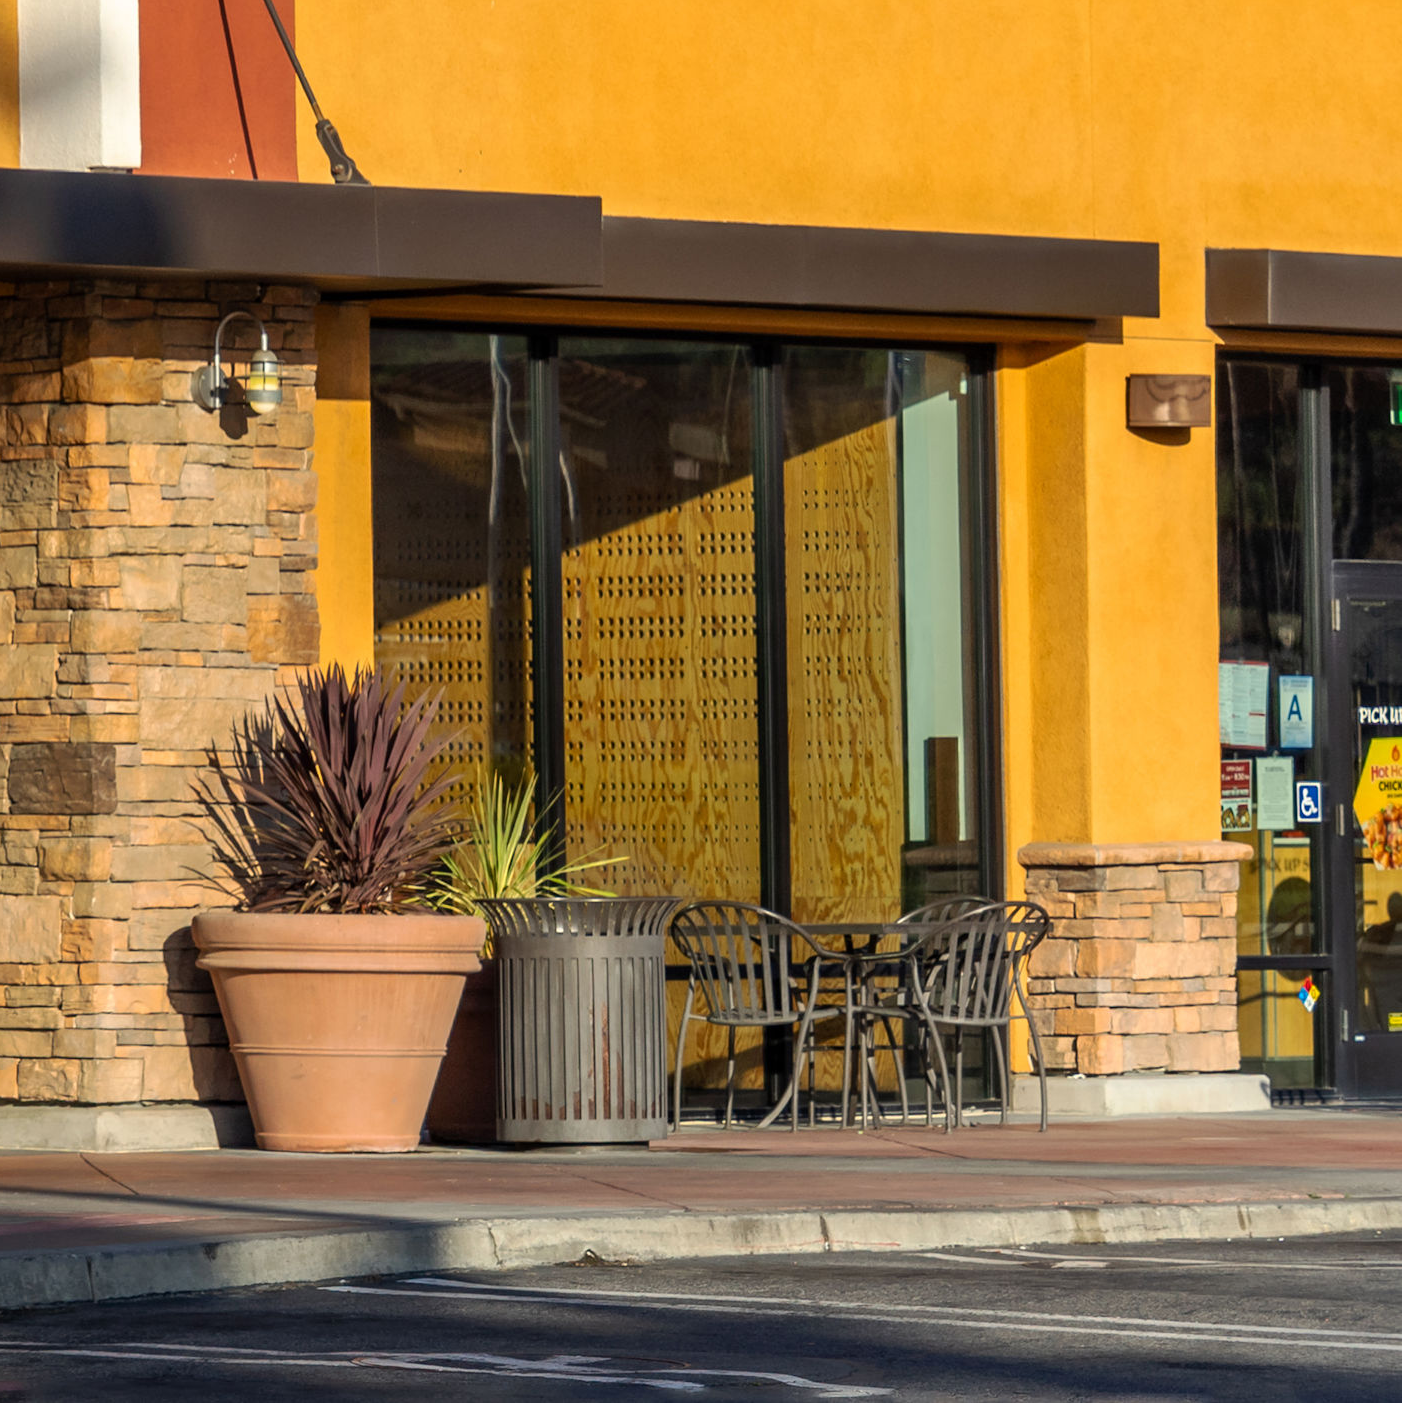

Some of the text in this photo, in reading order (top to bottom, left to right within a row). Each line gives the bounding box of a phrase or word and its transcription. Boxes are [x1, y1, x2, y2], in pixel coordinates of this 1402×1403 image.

[1288, 694, 1302, 721] A
[1359, 706, 1389, 725] PICK
[1371, 765, 1389, 782] Hot
